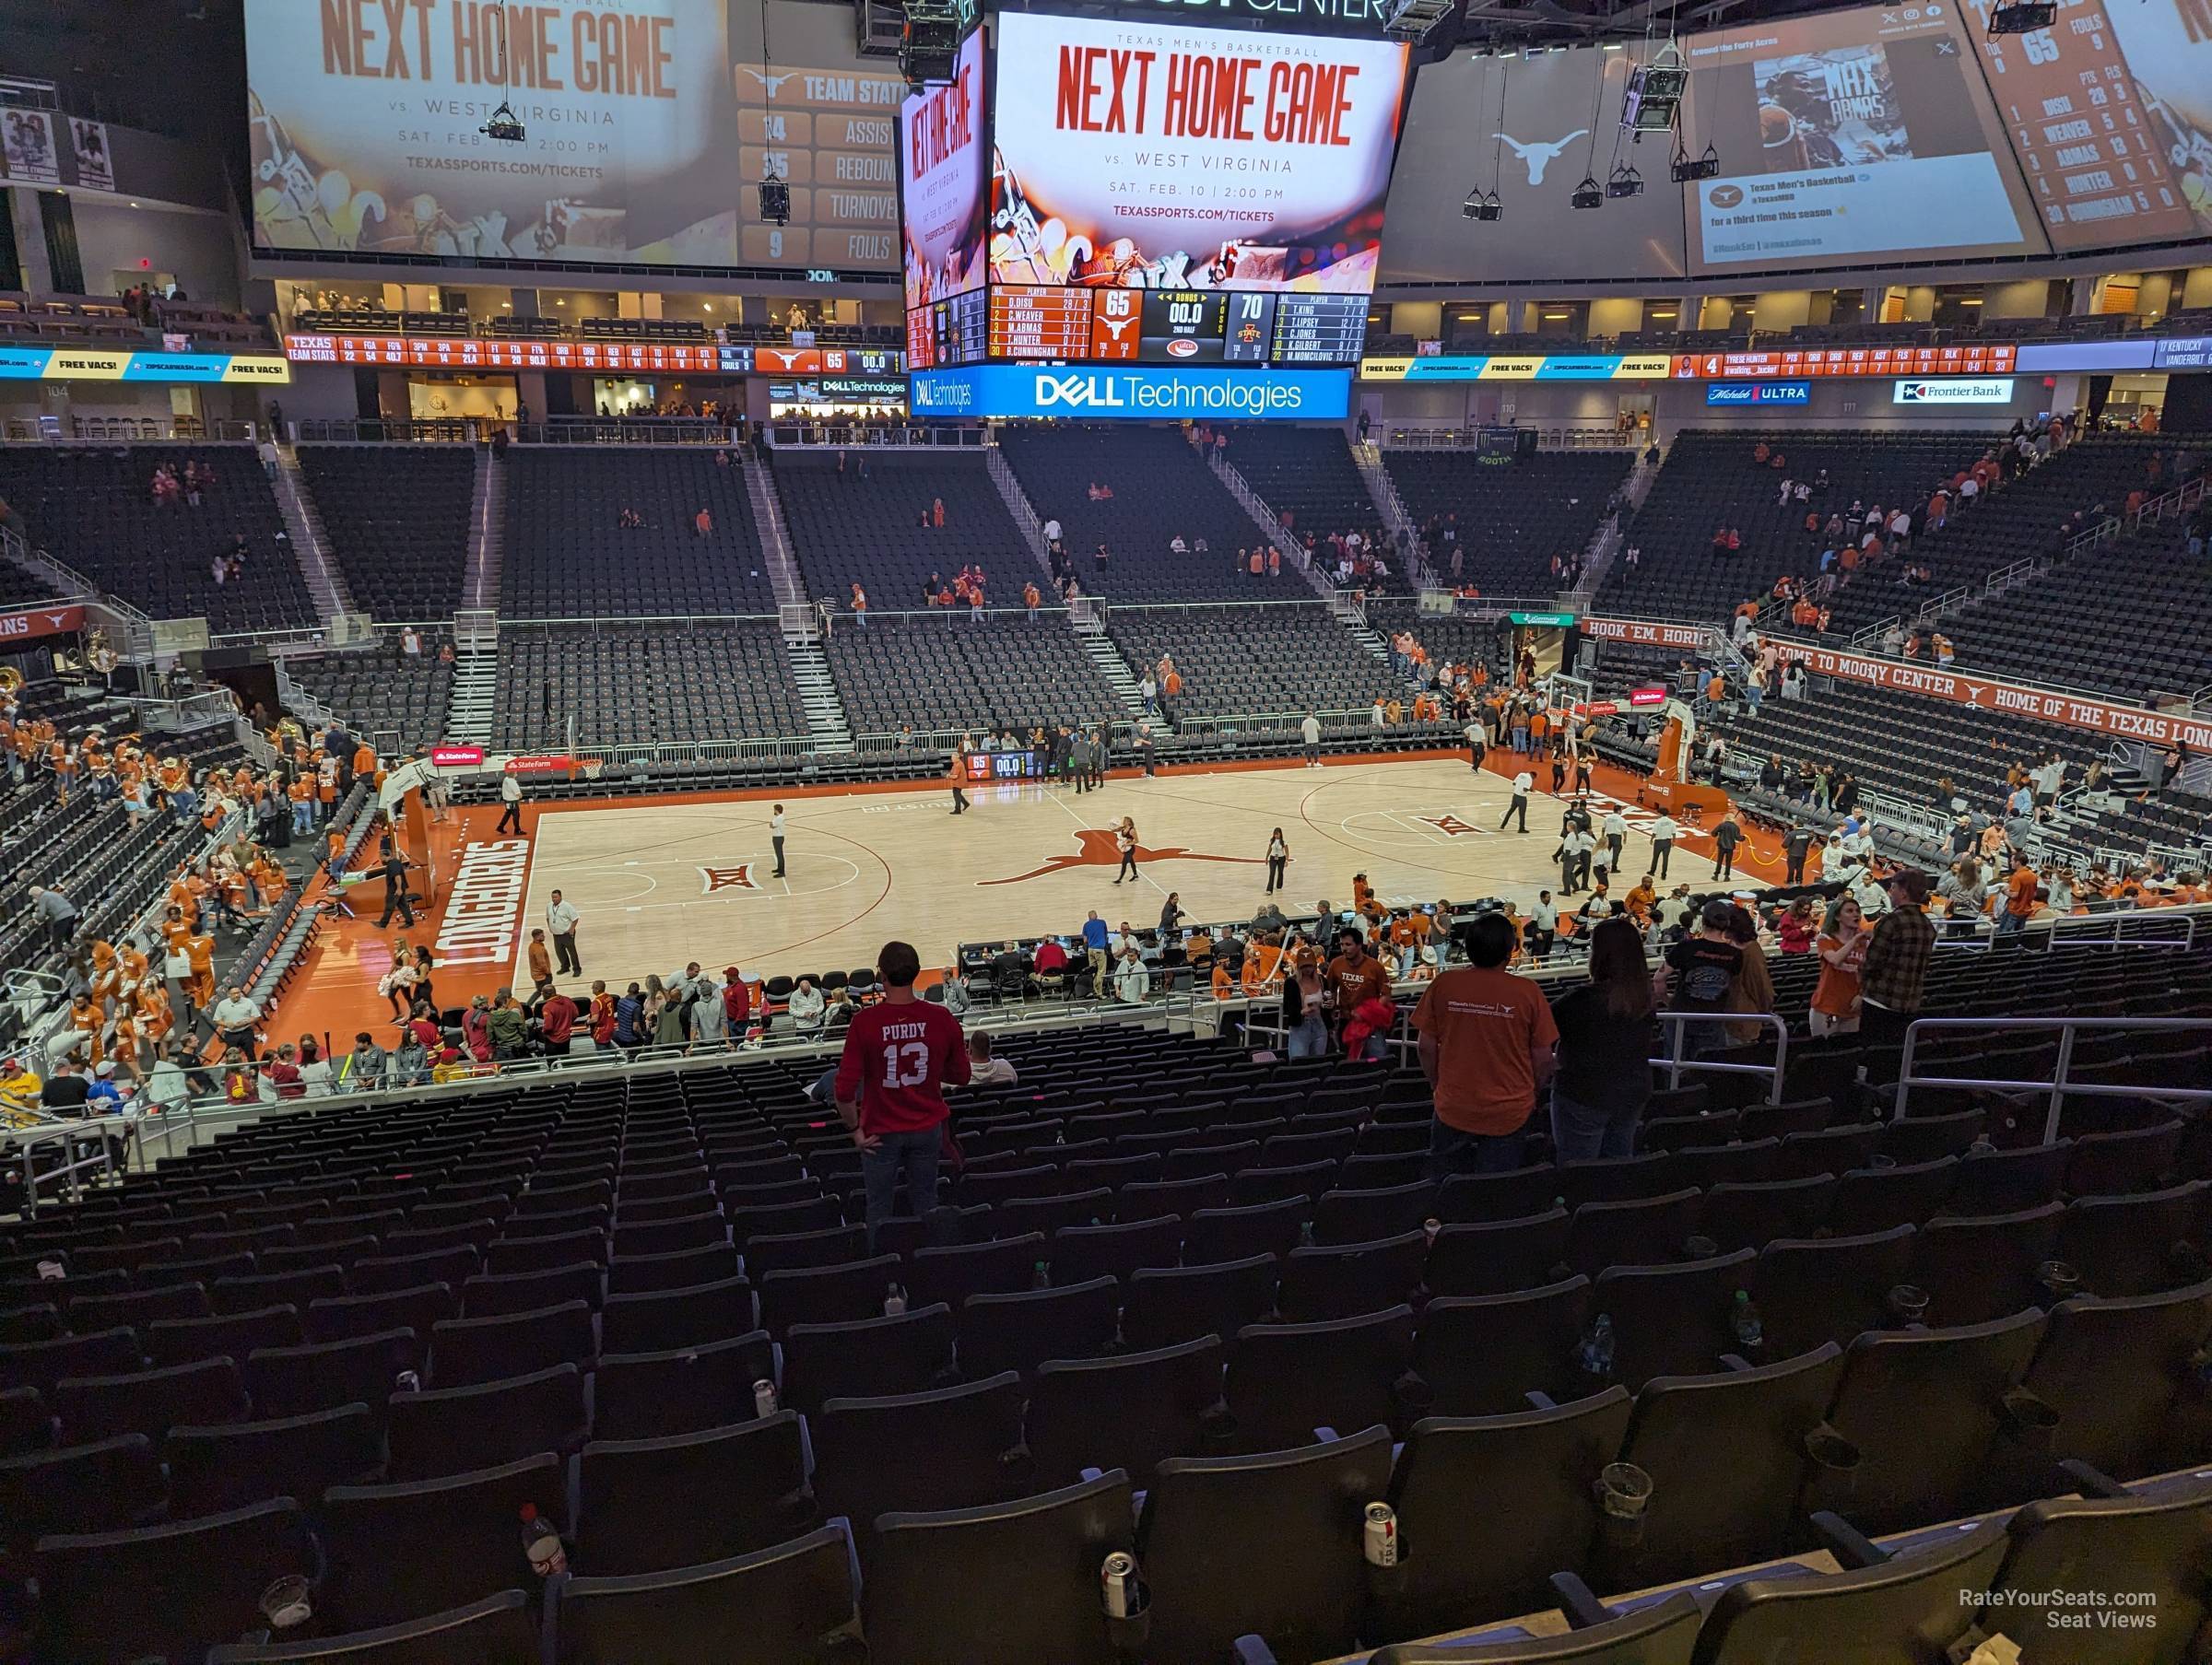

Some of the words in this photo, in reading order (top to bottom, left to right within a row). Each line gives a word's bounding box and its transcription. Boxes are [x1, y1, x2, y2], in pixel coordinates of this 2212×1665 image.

[1117, 34, 1164, 46] TEXAS
[1174, 39, 1218, 52] MEN'S
[1227, 42, 1319, 58] BASKETBALL
[2021, 29, 2060, 65] 65
[2070, 14, 2103, 35] FOULS
[2091, 34, 2103, 50] 9
[320, 0, 435, 81] NEXT
[453, 0, 564, 90] HOME
[572, 10, 677, 98] GAME
[1822, 57, 1880, 100] MAX
[804, 76, 855, 103] TEAM
[1055, 45, 1156, 135] NEXT
[1164, 53, 1262, 141] HOME
[1264, 61, 1360, 147] GAME
[425, 99, 493, 118] WEST
[1830, 94, 1885, 123] ABMAS
[2043, 120, 2093, 143] WEAVER
[398, 130, 430, 143] SAT.
[447, 133, 487, 147] FEB.
[539, 139, 577, 152] 2:00
[587, 142, 609, 154] PM
[912, 103, 928, 182] NEXT
[406, 156, 604, 179] TEXASSPORTS.COM/TICKETS
[836, 156, 896, 182] REBOUN
[1135, 152, 1190, 170] WEST
[1201, 156, 1292, 174] VIRGINIA
[1749, 183, 1776, 193] Texas
[1777, 180, 1805, 190] Men's
[1806, 174, 1855, 188] Basketball
[2065, 171, 2114, 194] HUNTER
[1109, 182, 1141, 193] SAT.
[1149, 183, 1182, 196] FEB.
[1190, 186, 1205, 197] 10
[1225, 187, 1257, 200] 2:00
[1265, 189, 1284, 201] PM
[831, 194, 898, 219] TURNOVE
[1113, 205, 1276, 223] TEXASSPORTS.COM/TICKETS
[1711, 217, 1724, 227] for
[1734, 215, 1755, 225] third
[1757, 213, 1777, 223] time
[1779, 211, 1797, 220] this
[1798, 208, 1832, 219] season
[769, 231, 782, 258] 9
[847, 234, 890, 260] FOULS
[1008, 298, 1033, 308] D.DISU
[1063, 299, 1073, 309] 28
[1106, 291, 1129, 316] 65
[1175, 293, 1197, 301] BONUS
[1170, 303, 1202, 323] 00.0
[1241, 295, 1263, 319] 70
[1293, 305, 1314, 315] T.KING
[1008, 311, 1043, 321] C.WEAVER
[1291, 317, 1319, 327] T.LIPSEY
[291, 336, 332, 348] TEXAS
[1290, 329, 1316, 338] C.JONES
[631, 347, 642, 357] AST
[676, 348, 687, 358] BLK
[991, 346, 1000, 356] 30
[1006, 346, 1057, 357] B.CUNNINGHAM
[1288, 341, 1321, 350] K.GILBERT
[2168, 341, 2203, 352] KENTUCKY
[288, 349, 310, 360] TEAM
[312, 349, 335, 361] STATS
[345, 351, 355, 361] 22
[385, 352, 401, 362] 40.7
[609, 358, 618, 367] 35
[827, 354, 841, 368] 65
[863, 356, 886, 369] 00.0
[1273, 352, 1281, 360] 22
[1287, 352, 1333, 361] M.MOMCILOVIC
[2166, 354, 2204, 365] VANDERBILT
[59, 360, 86, 369] FREE
[88, 361, 117, 369] VACS!
[231, 365, 255, 373] FREE
[257, 366, 283, 374] VACS!
[722, 360, 739, 370] FOULS
[1512, 364, 1533, 372] VACS!
[1642, 363, 1665, 371] VACS!
[1706, 357, 1717, 373] 4
[1995, 361, 2006, 370] 33
[47, 385, 68, 397] 104
[823, 381, 850, 391] DELL
[850, 381, 905, 393] Technologies
[1036, 374, 1124, 407] DELL
[1124, 377, 1301, 416] Technologies
[1708, 387, 1750, 402] Michelob
[1761, 387, 1806, 400] ULTRA
[1927, 385, 1971, 397] Frontier
[1972, 385, 2002, 396] Bank
[916, 381, 932, 406] DELL
[932, 383, 971, 416] Technologies
[1589, 621, 1626, 638] HOOK
[1818, 653, 1834, 671] TO
[1839, 658, 1888, 681] MOODY
[1892, 668, 1955, 695] CENTER
[1994, 688, 2041, 713] HOME
[2044, 698, 2065, 717] OF
[2069, 703, 2104, 726] THE
[2109, 710, 2168, 739] TEXAS
[973, 756, 985, 768] 65
[997, 758, 1019, 772] 00.0
[321, 779, 332, 787] 35
[432, 839, 530, 968] LONGHORNS
[1342, 972, 1365, 983] TEXAS
[882, 1022, 927, 1042] PURDY
[882, 1041, 929, 1088] 13
